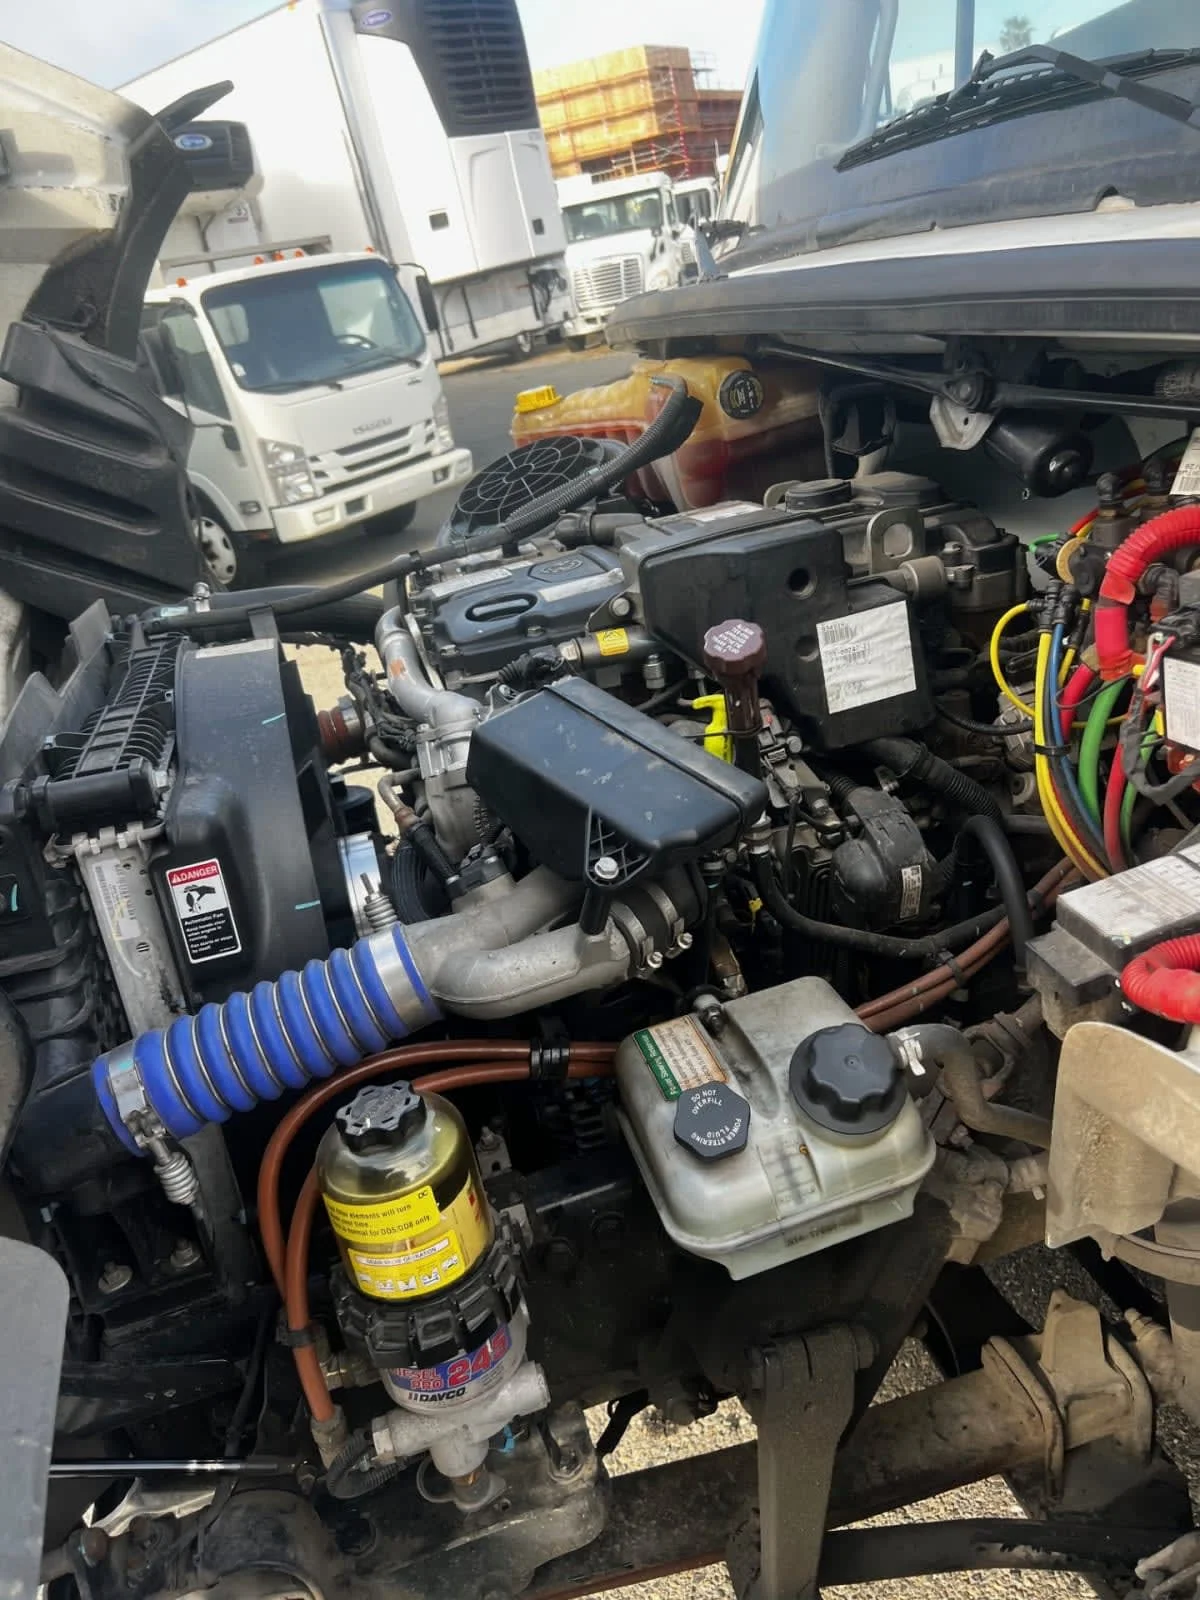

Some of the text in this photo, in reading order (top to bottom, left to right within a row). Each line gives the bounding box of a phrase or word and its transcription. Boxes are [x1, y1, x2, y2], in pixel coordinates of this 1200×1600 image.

[180, 866, 218, 881] DANGER
[691, 1089, 717, 1102] DO NOT
[692, 1098, 722, 1115] OVERFILL
[690, 1118, 742, 1146] POWER STEERING
[706, 1125, 730, 1138] FLUID
[382, 1208, 395, 1218] will
[446, 1327, 507, 1388] 245
[410, 1378, 444, 1390] PRO
[418, 1387, 466, 1402] DAVCO
